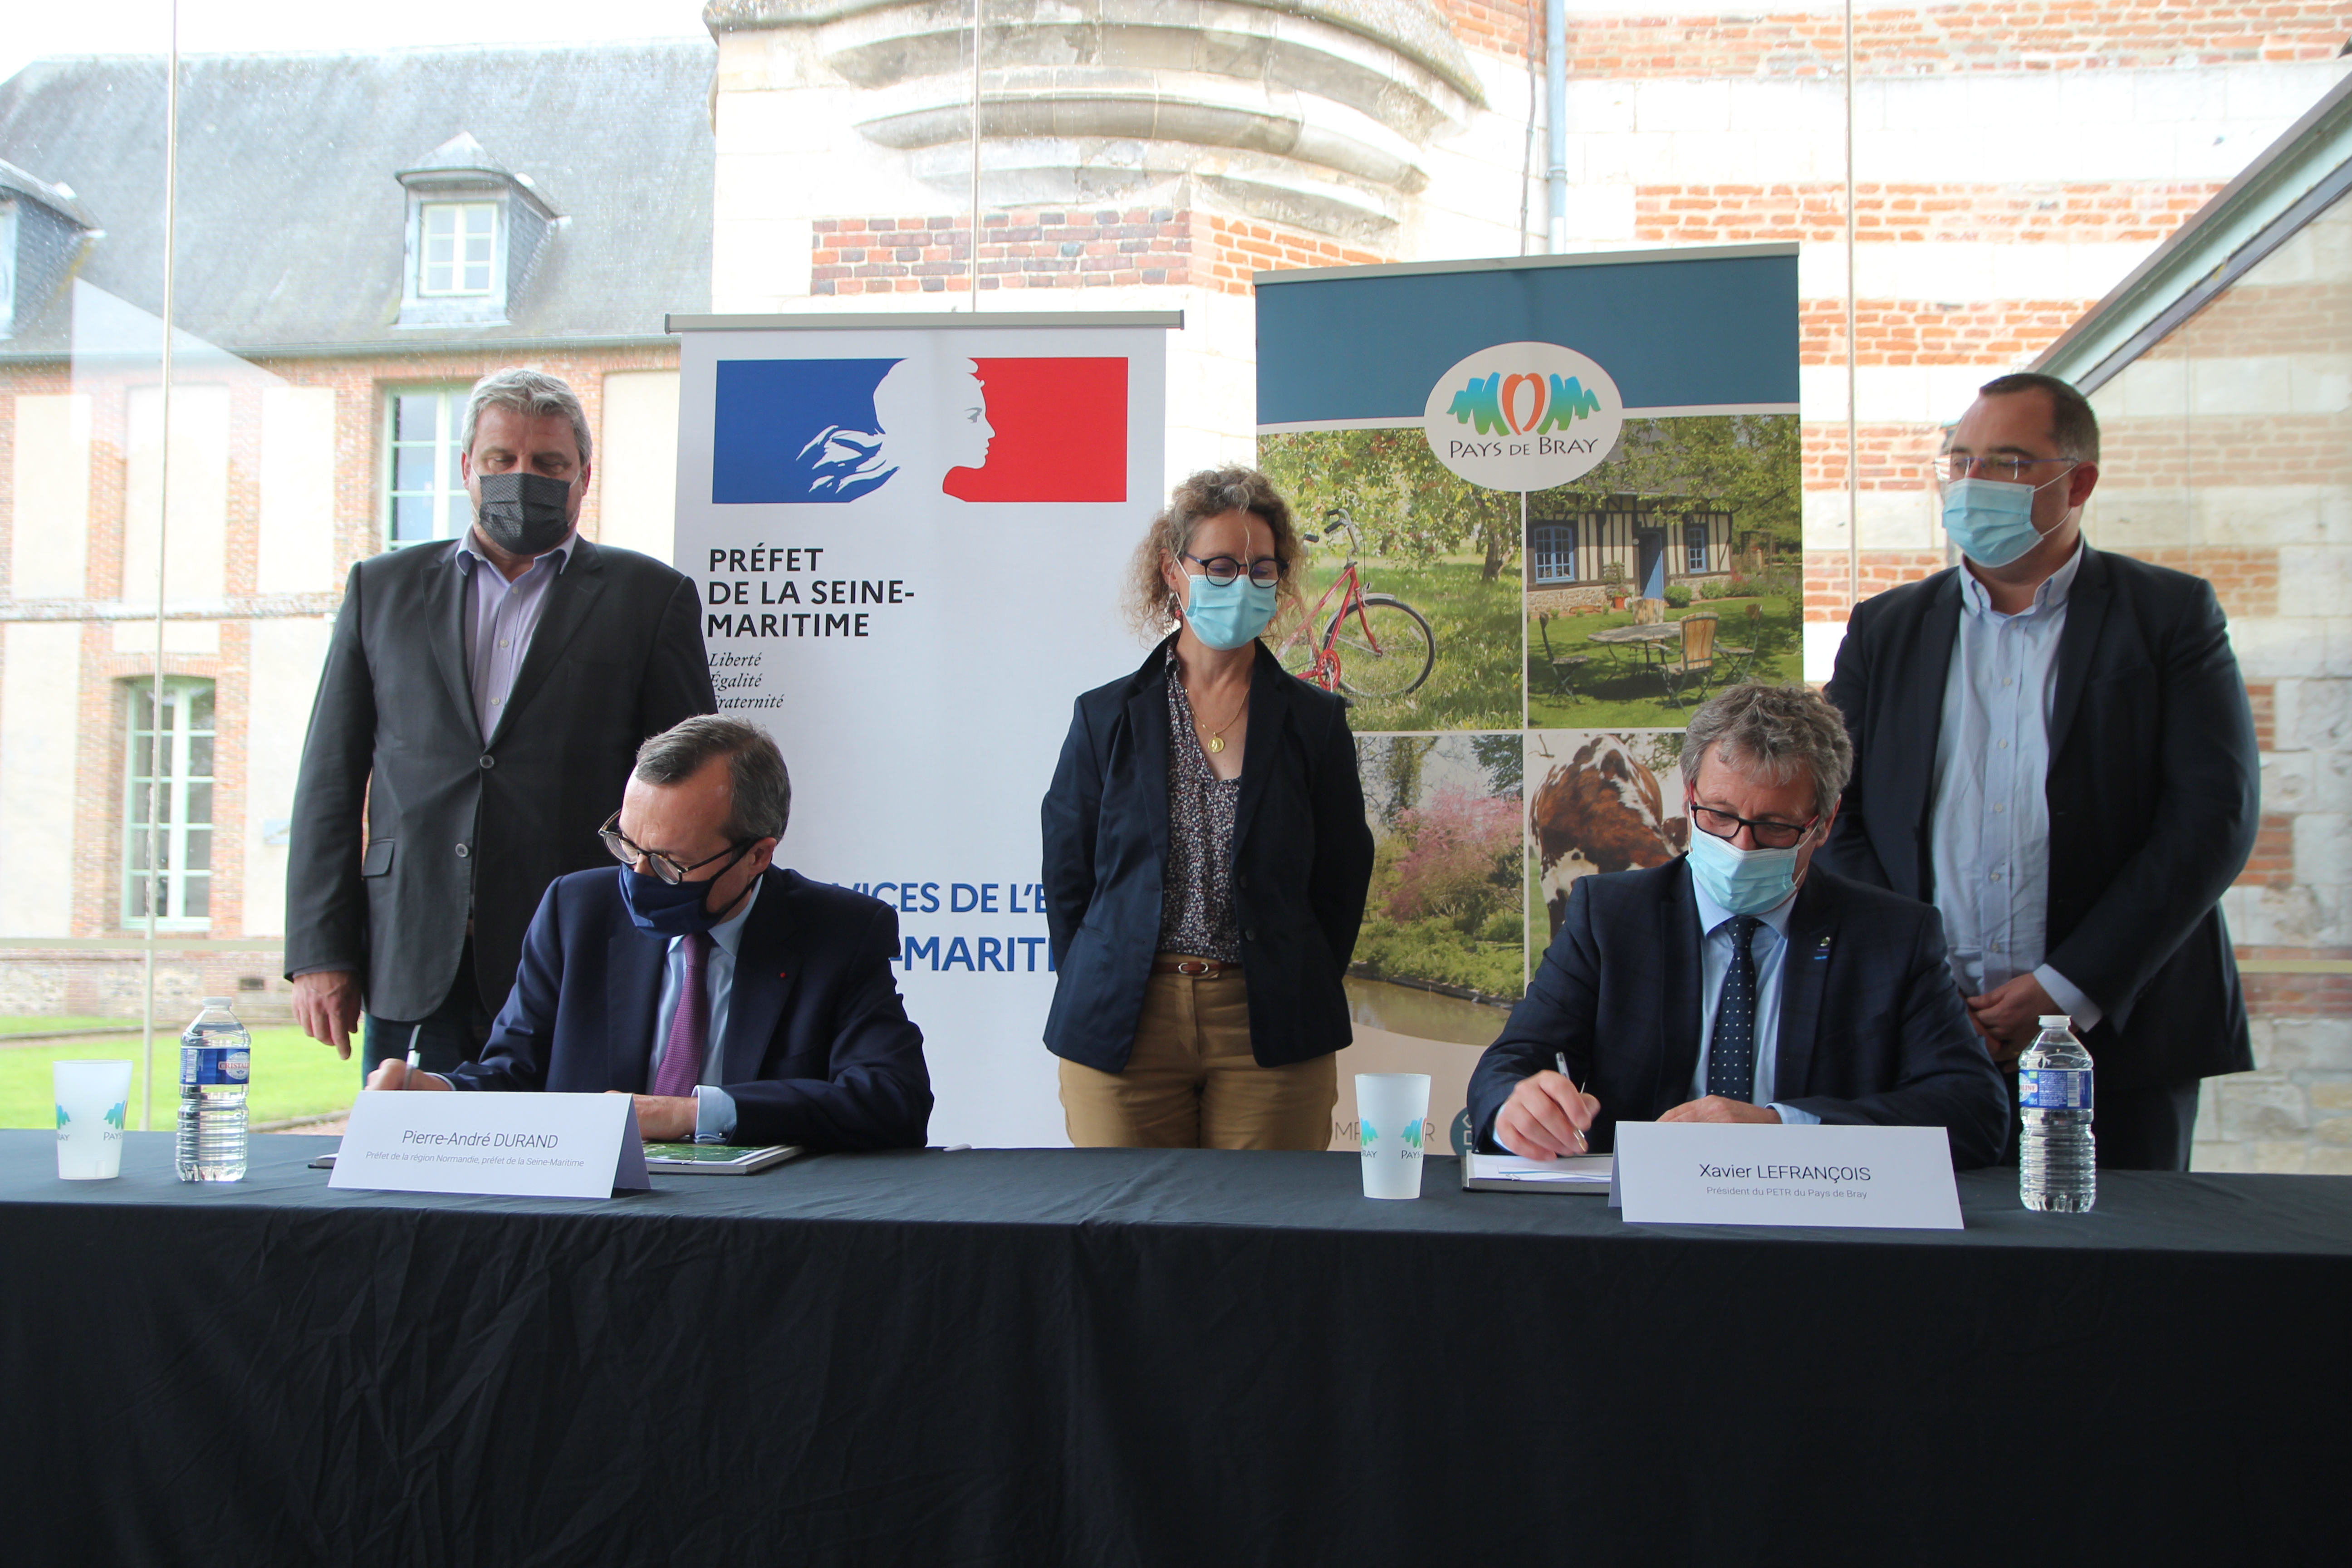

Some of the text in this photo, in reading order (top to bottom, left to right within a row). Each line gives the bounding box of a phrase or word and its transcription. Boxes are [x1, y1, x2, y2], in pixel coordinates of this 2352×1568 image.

[1450, 437, 1599, 458] PAYS DE BRAY
[710, 543, 823, 572] PRÉFET
[708, 580, 915, 604] DE LA SEINE-
[708, 613, 869, 637] MARITIME
[709, 652, 763, 667] Liberté
[710, 671, 763, 691] Égalité
[951, 883, 999, 913] DE
[402, 1130, 559, 1148] Pierre-André DURAND
[366, 1151, 389, 1160] Préfet
[410, 1153, 435, 1163] région
[436, 1155, 480, 1164] Normandie,
[481, 1156, 505, 1165] préfet
[526, 1157, 584, 1167] Seine-Maritime
[1401, 1150, 1420, 1159] PAYS
[1699, 1164, 1871, 1184] Xavier LEFRANÇOIS
[1707, 1186, 1750, 1195] Président
[1752, 1187, 1764, 1196] du
[1766, 1188, 1792, 1196] PETR
[1808, 1189, 1830, 1199] Pays
[1847, 1190, 1867, 1199] Bray
